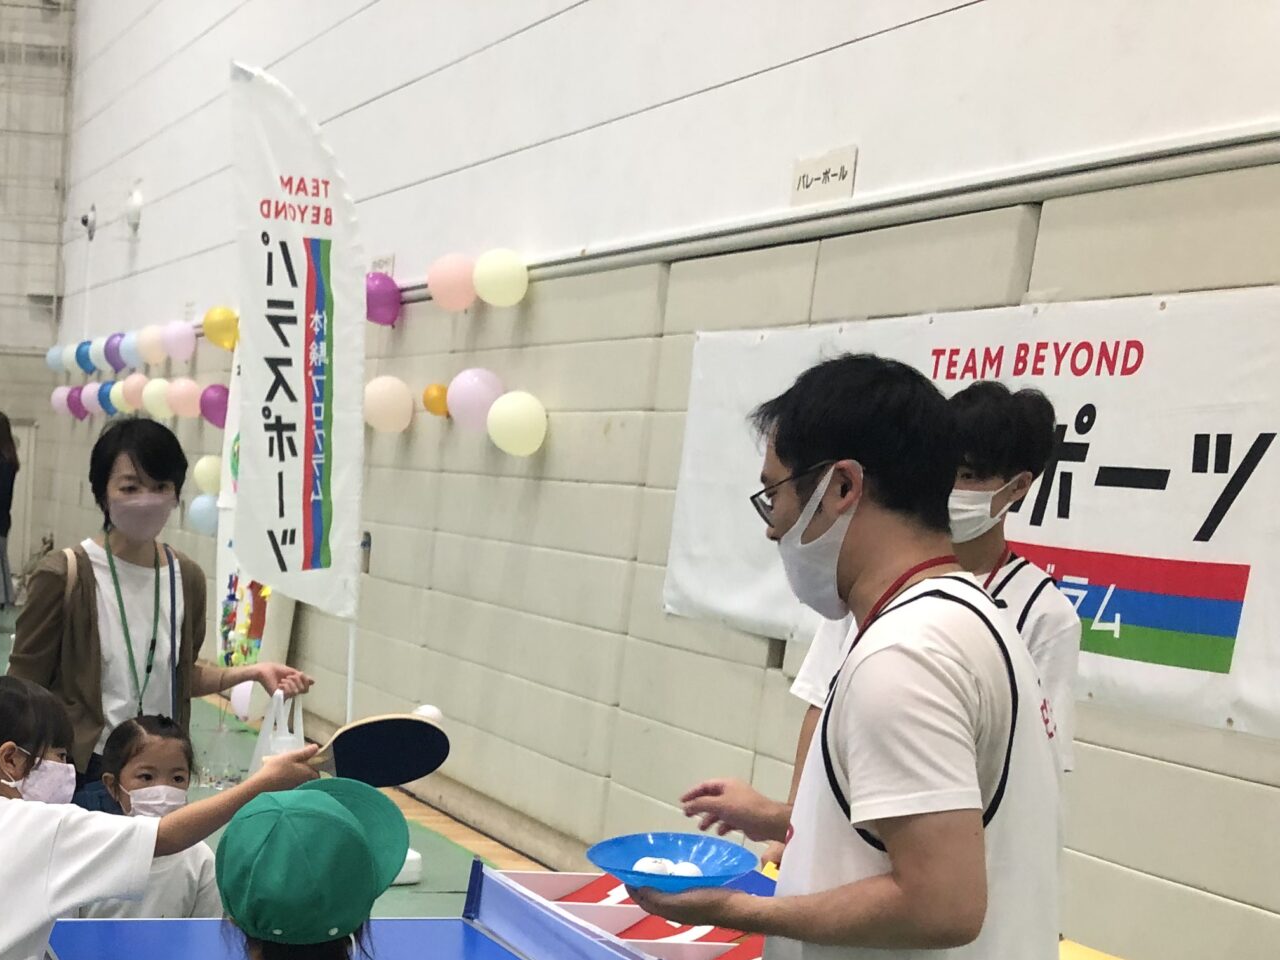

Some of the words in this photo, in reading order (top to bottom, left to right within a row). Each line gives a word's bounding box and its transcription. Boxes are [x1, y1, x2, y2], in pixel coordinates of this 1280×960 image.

[931, 345, 1005, 381] TEAM
[1012, 339, 1145, 377] BEYOND
[1046, 563, 1121, 639] ラム
